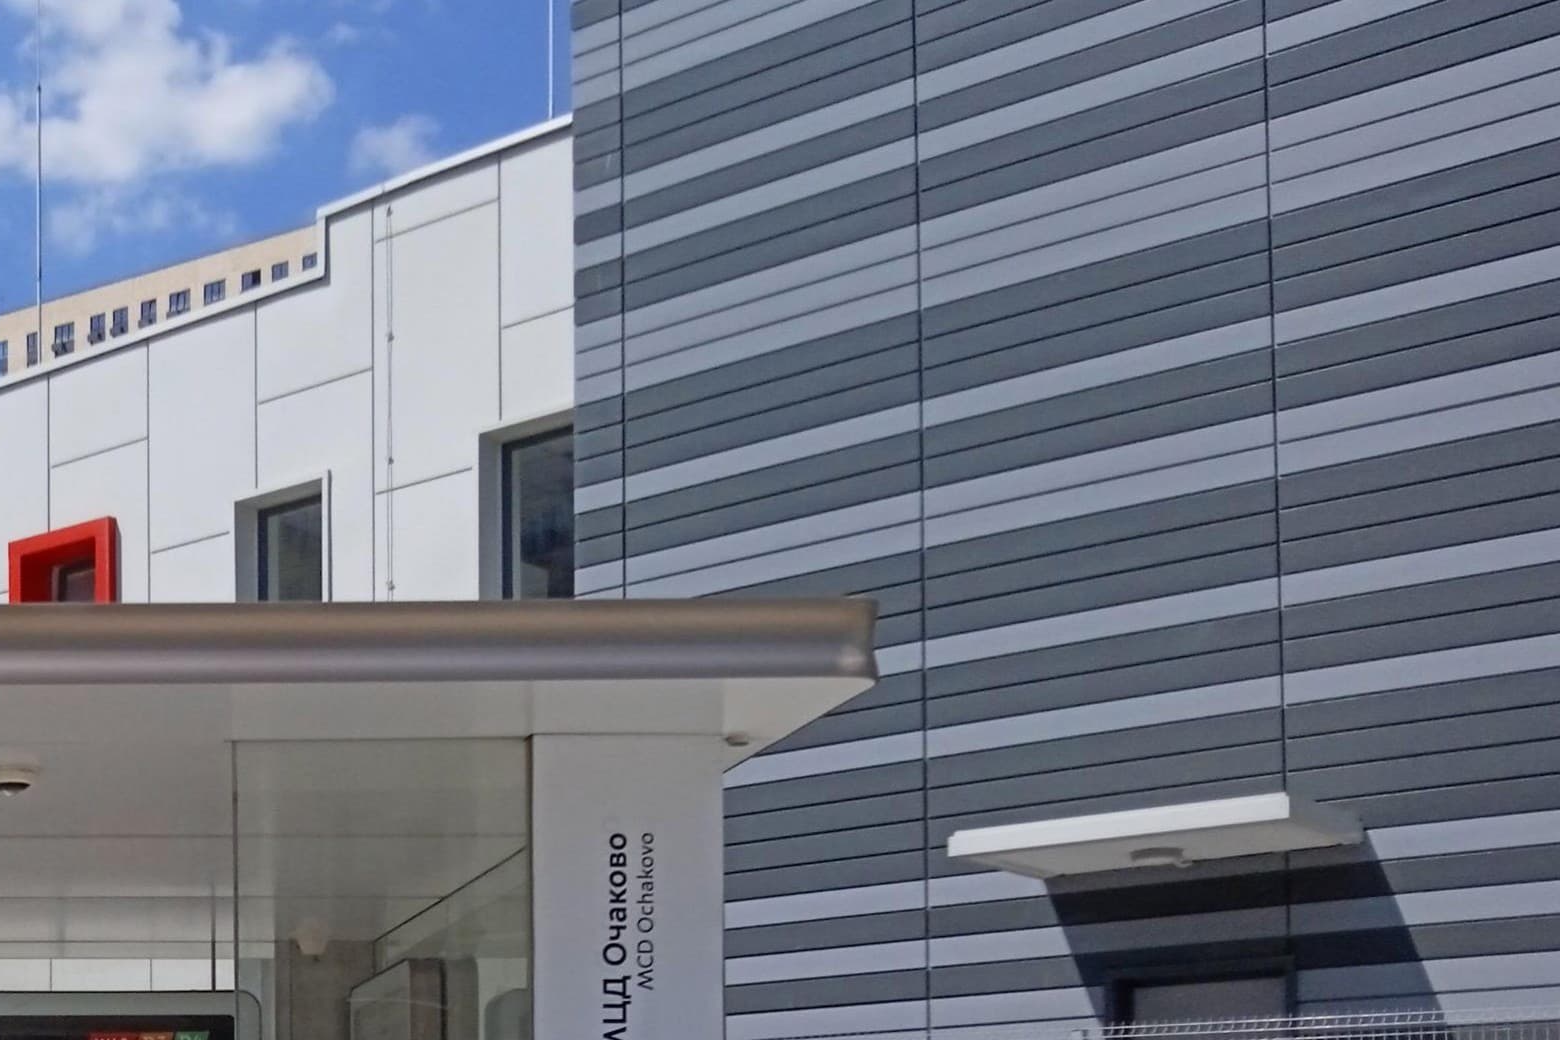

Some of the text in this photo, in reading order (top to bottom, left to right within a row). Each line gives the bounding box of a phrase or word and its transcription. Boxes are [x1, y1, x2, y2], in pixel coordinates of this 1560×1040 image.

[602, 833, 628, 966] Очаково
[636, 832, 655, 991] MCD Ochakovo
